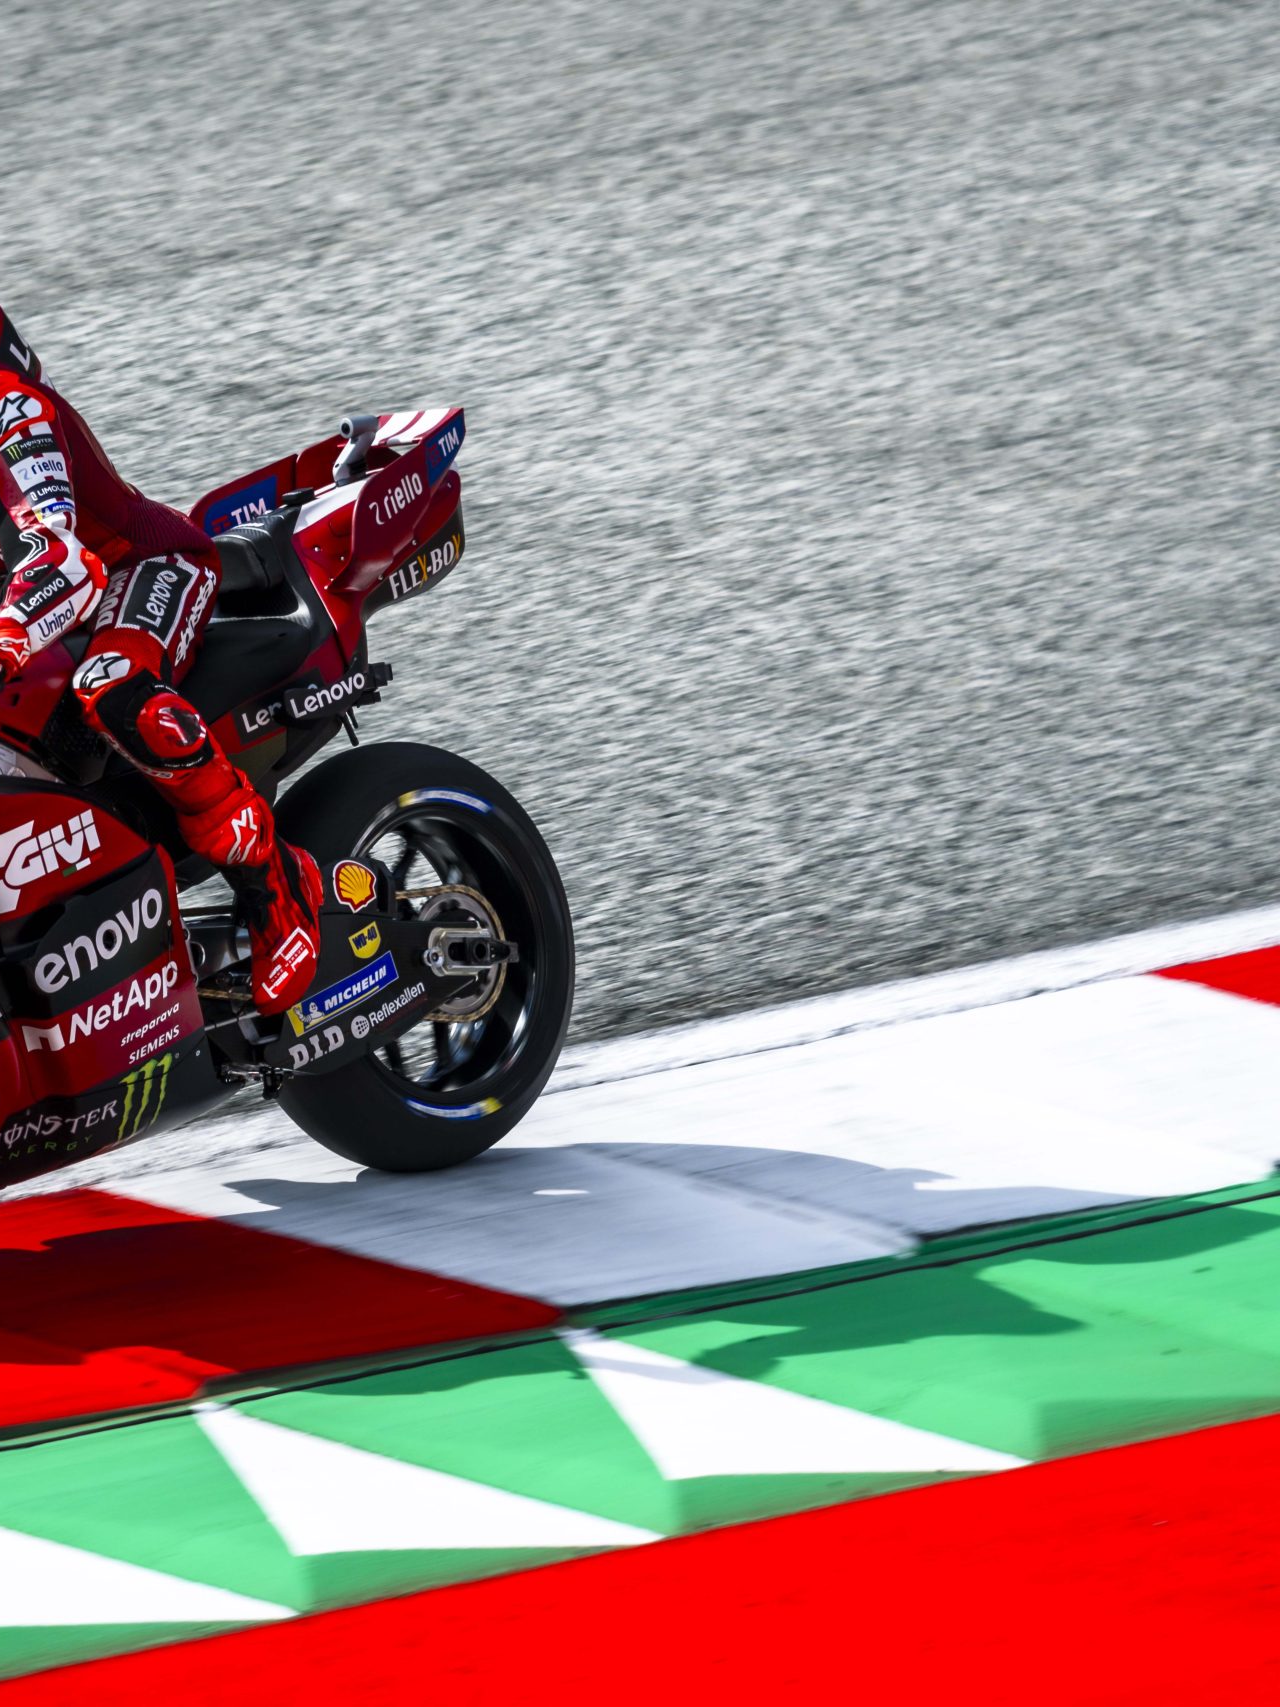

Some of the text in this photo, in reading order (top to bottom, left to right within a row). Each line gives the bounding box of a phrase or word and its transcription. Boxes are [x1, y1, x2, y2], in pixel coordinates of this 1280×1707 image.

[437, 427, 460, 457] TIM
[31, 460, 64, 475] riello
[231, 497, 268, 526] TIM
[384, 472, 423, 520] riello
[389, 532, 461, 600] FLEX-BOX
[19, 577, 65, 612] Lenovo
[136, 570, 178, 628] Lenovo
[38, 601, 75, 638] Unipol
[290, 672, 365, 719] Lenovo
[4, 808, 102, 889] GIVI
[353, 928, 377, 950] WD-40
[69, 960, 179, 1044] NetApp
[323, 965, 387, 1012] MICHELIN
[369, 982, 425, 1028] Reflexallen
[120, 1002, 180, 1047] streparava
[128, 1025, 180, 1065] SIEMENS
[288, 1025, 345, 1069] D.I.D
